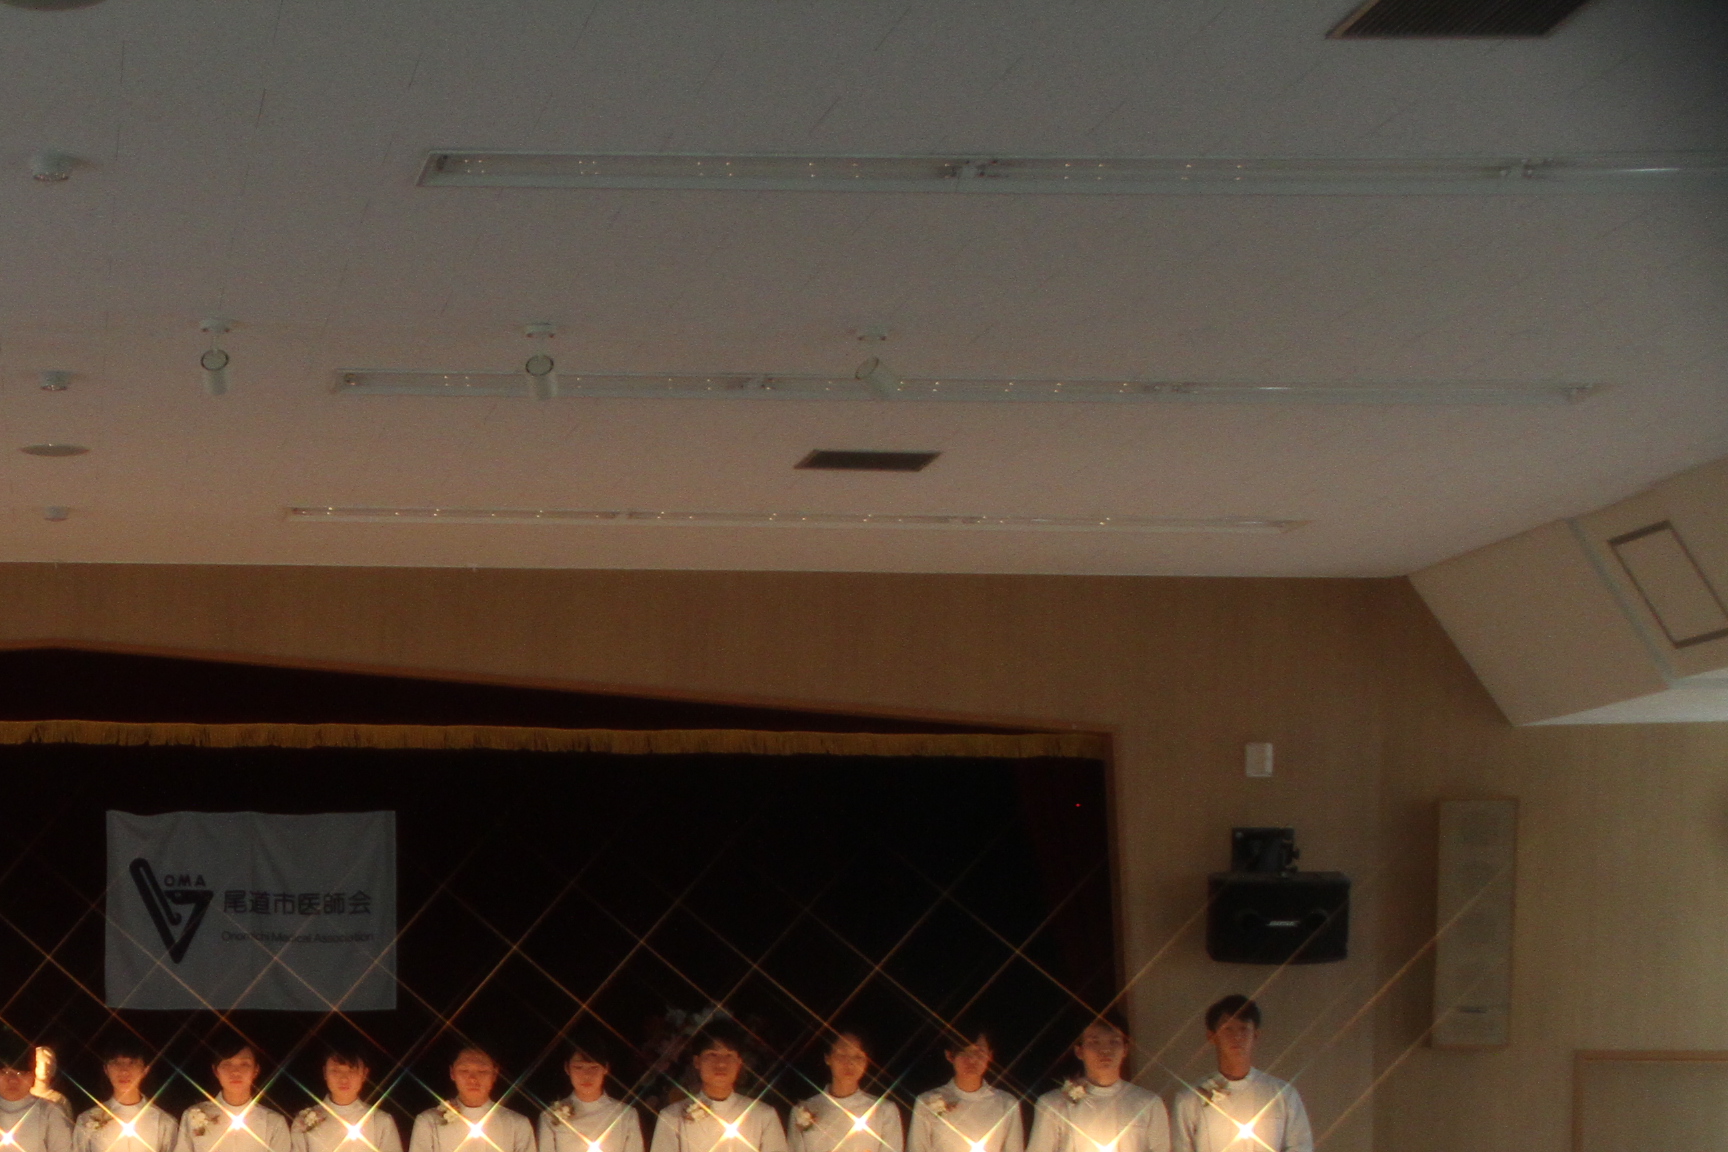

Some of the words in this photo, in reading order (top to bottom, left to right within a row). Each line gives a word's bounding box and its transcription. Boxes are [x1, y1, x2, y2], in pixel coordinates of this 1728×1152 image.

[164, 875, 206, 887] OMA
[223, 889, 371, 914] 尾道市医師会
